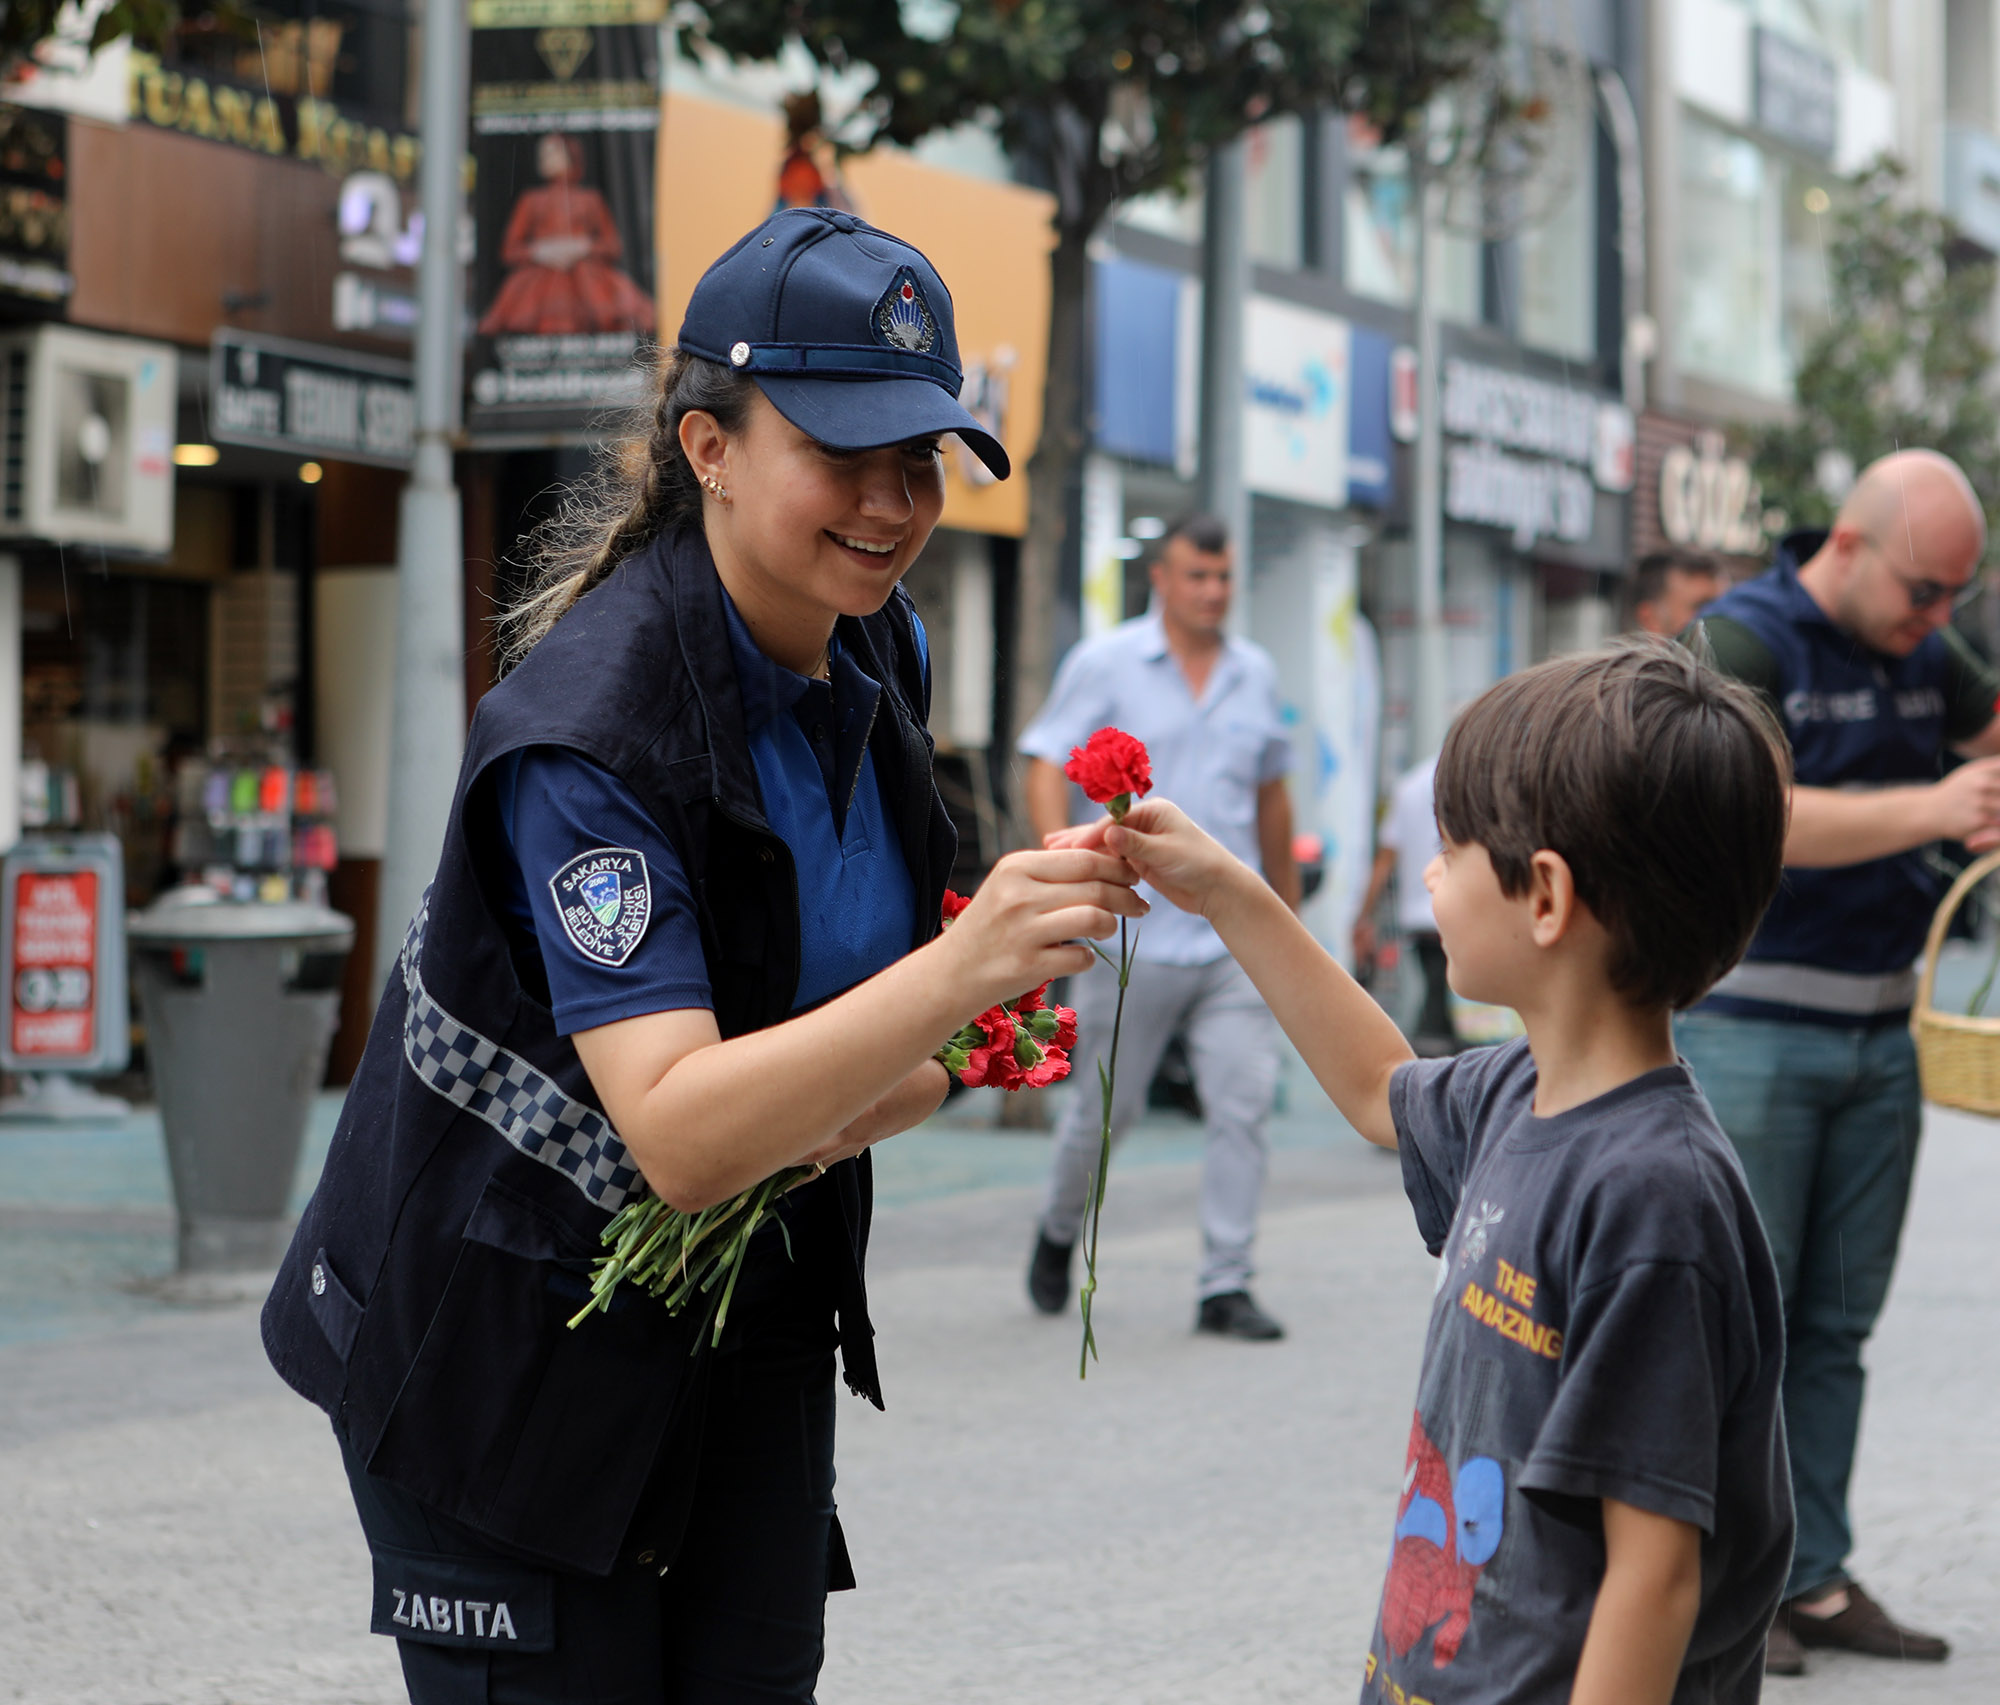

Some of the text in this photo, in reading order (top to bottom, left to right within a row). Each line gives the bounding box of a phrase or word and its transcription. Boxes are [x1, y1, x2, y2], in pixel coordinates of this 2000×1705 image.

[562, 857, 632, 892] SAKARYA
[565, 884, 647, 956] BELEDİYE ZABITASI
[575, 905, 614, 940] BÜYÜK
[1496, 1257, 1538, 1309] THE
[1462, 1281, 1564, 1359] AMAZING
[392, 1588, 518, 1640] ZABITA
